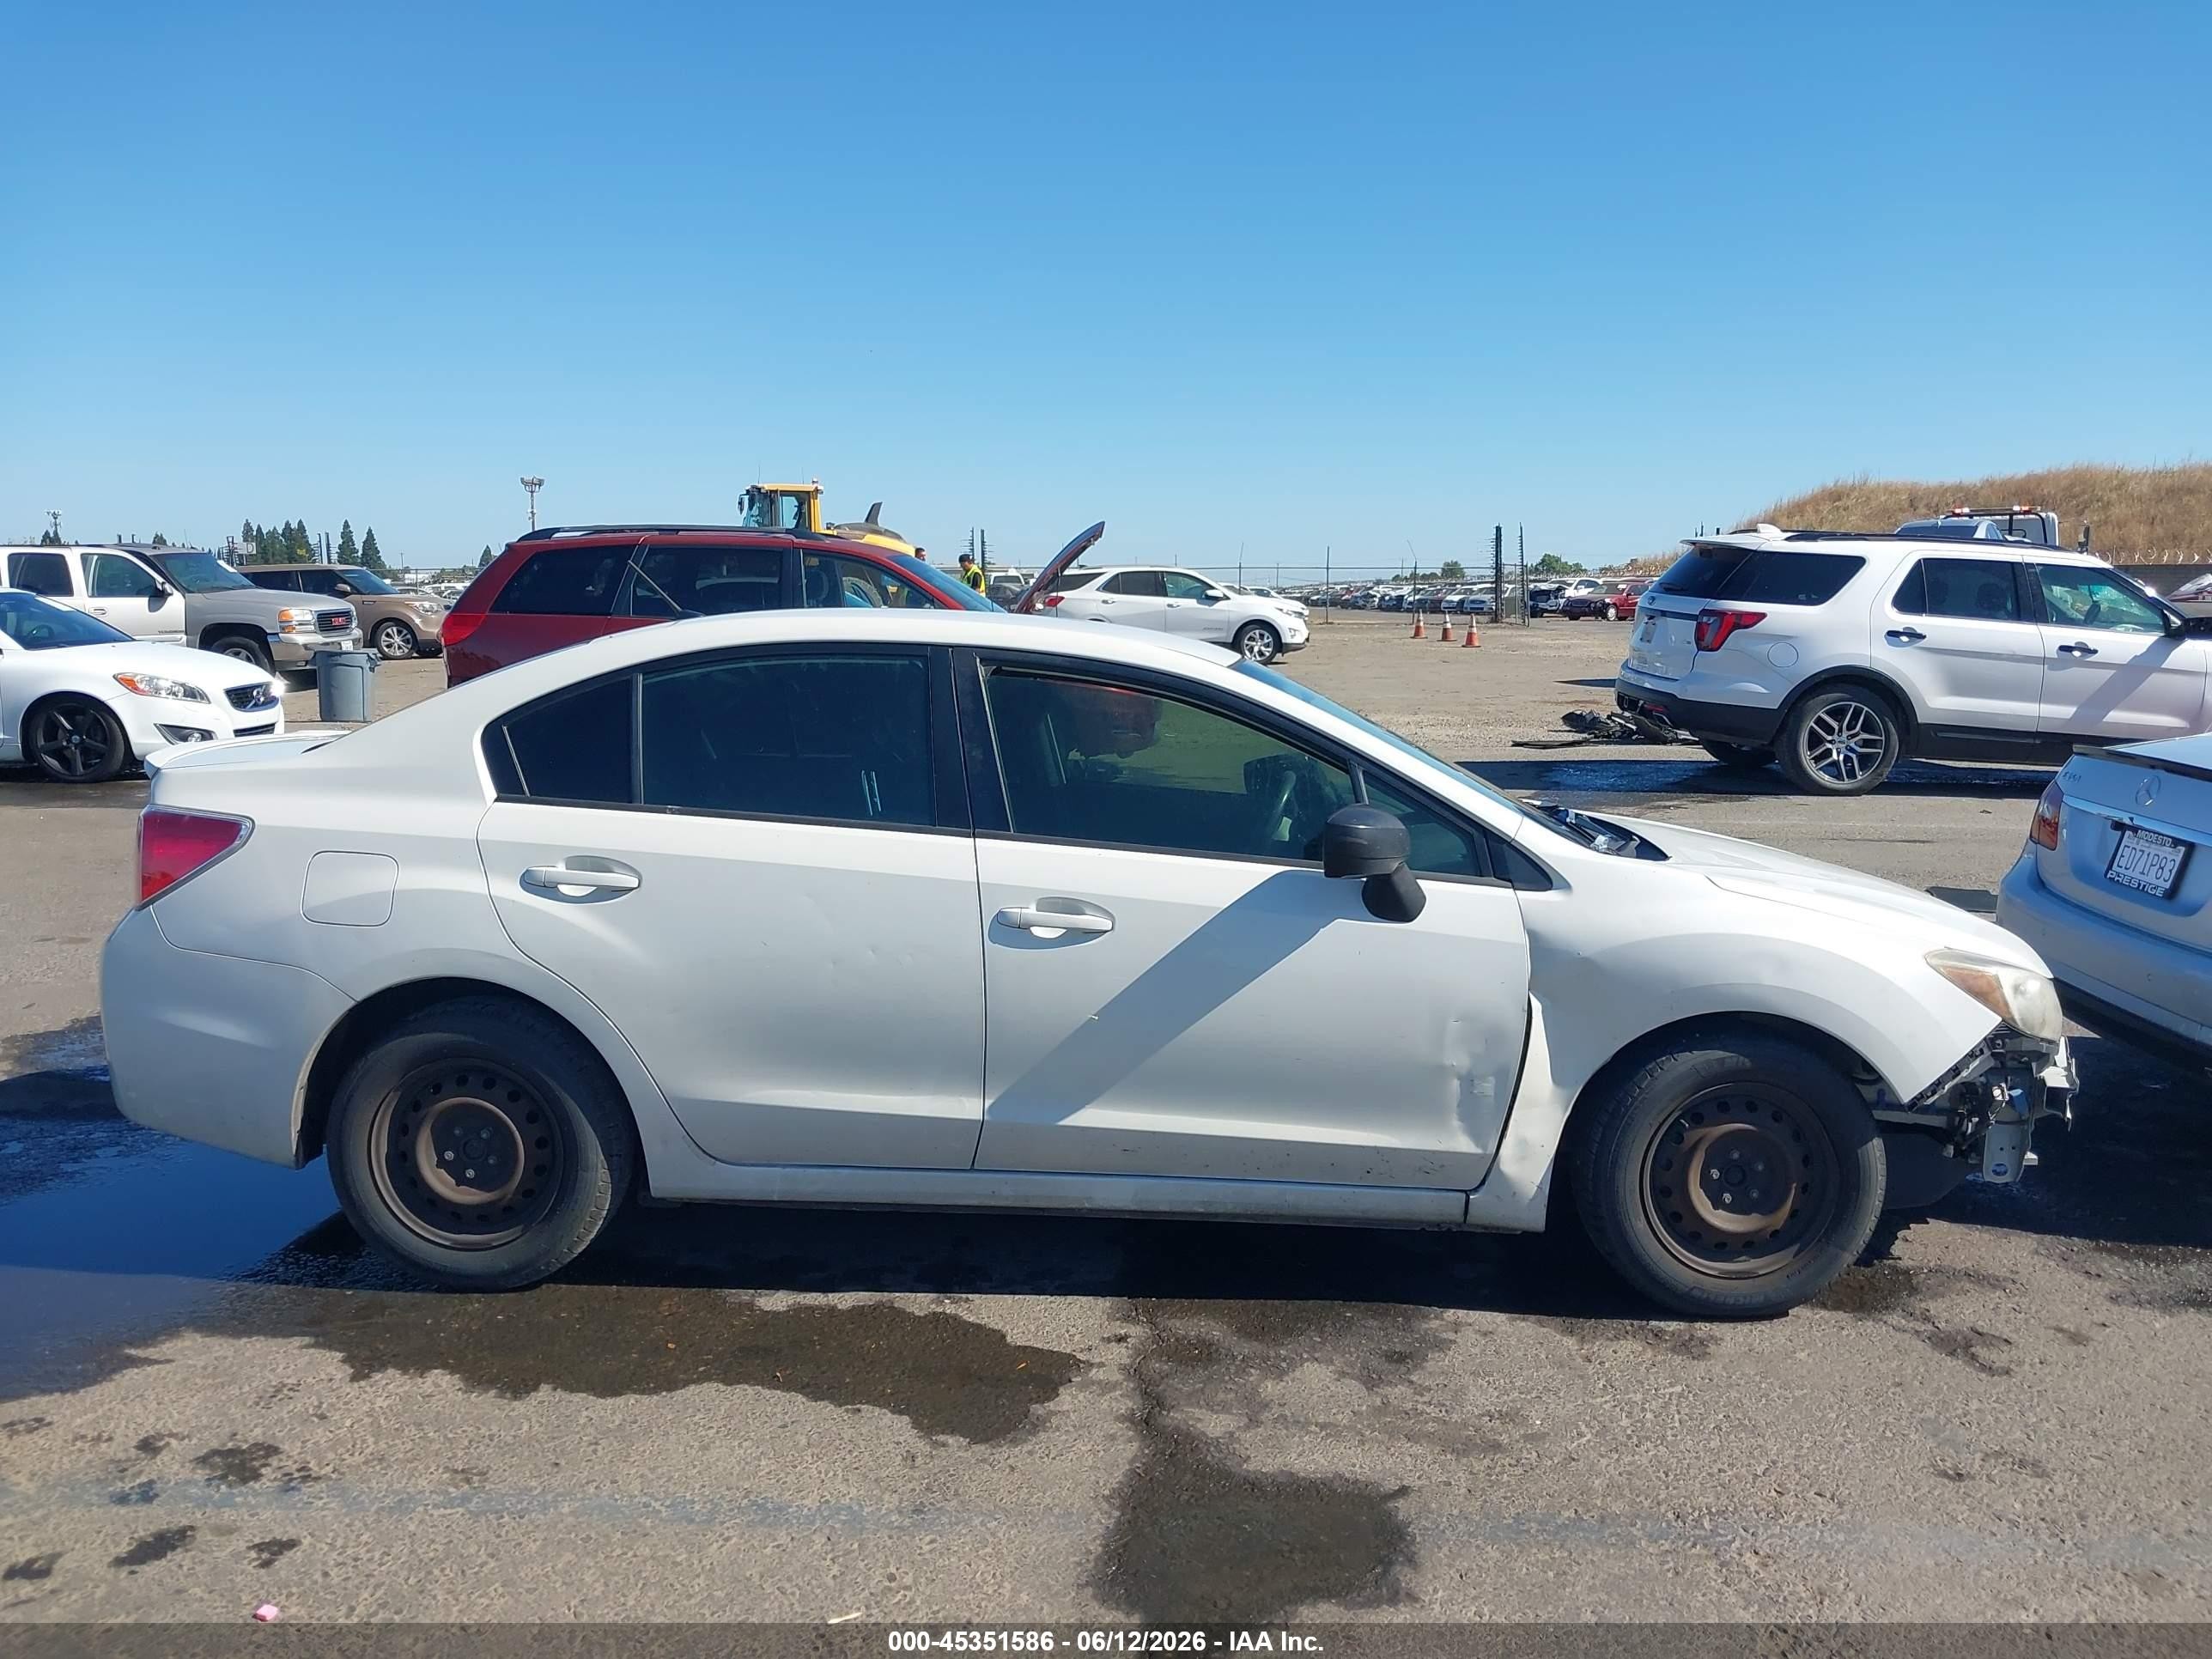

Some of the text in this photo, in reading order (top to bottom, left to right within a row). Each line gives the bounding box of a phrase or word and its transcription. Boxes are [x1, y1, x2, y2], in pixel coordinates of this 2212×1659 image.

[246, 543, 255, 554] D
[2136, 830, 2172, 847] MODESTO
[2117, 845, 2176, 883] ED71P83
[2106, 870, 2166, 897] PRESTIGE
